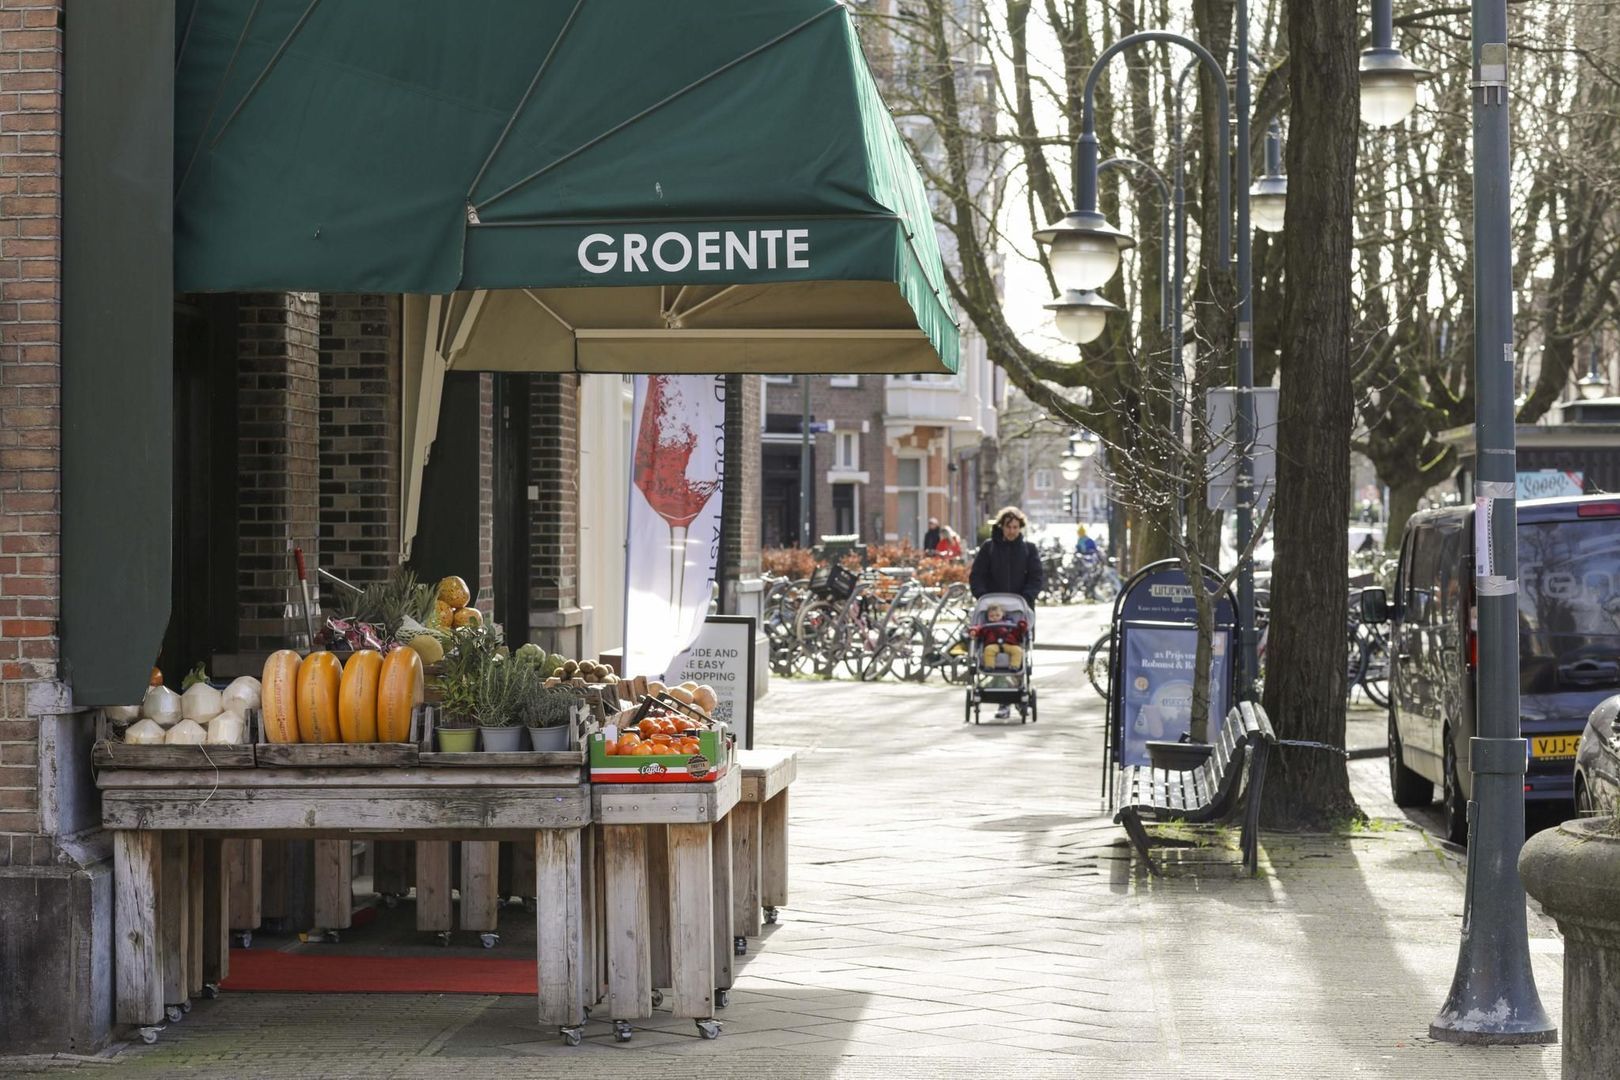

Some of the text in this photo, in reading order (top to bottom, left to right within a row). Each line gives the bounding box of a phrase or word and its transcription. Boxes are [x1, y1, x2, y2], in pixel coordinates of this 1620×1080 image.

[577, 229, 809, 274] GROENTE
[715, 649, 738, 658] AND
[697, 660, 725, 670] EASY
[680, 671, 736, 681] SHOPPING
